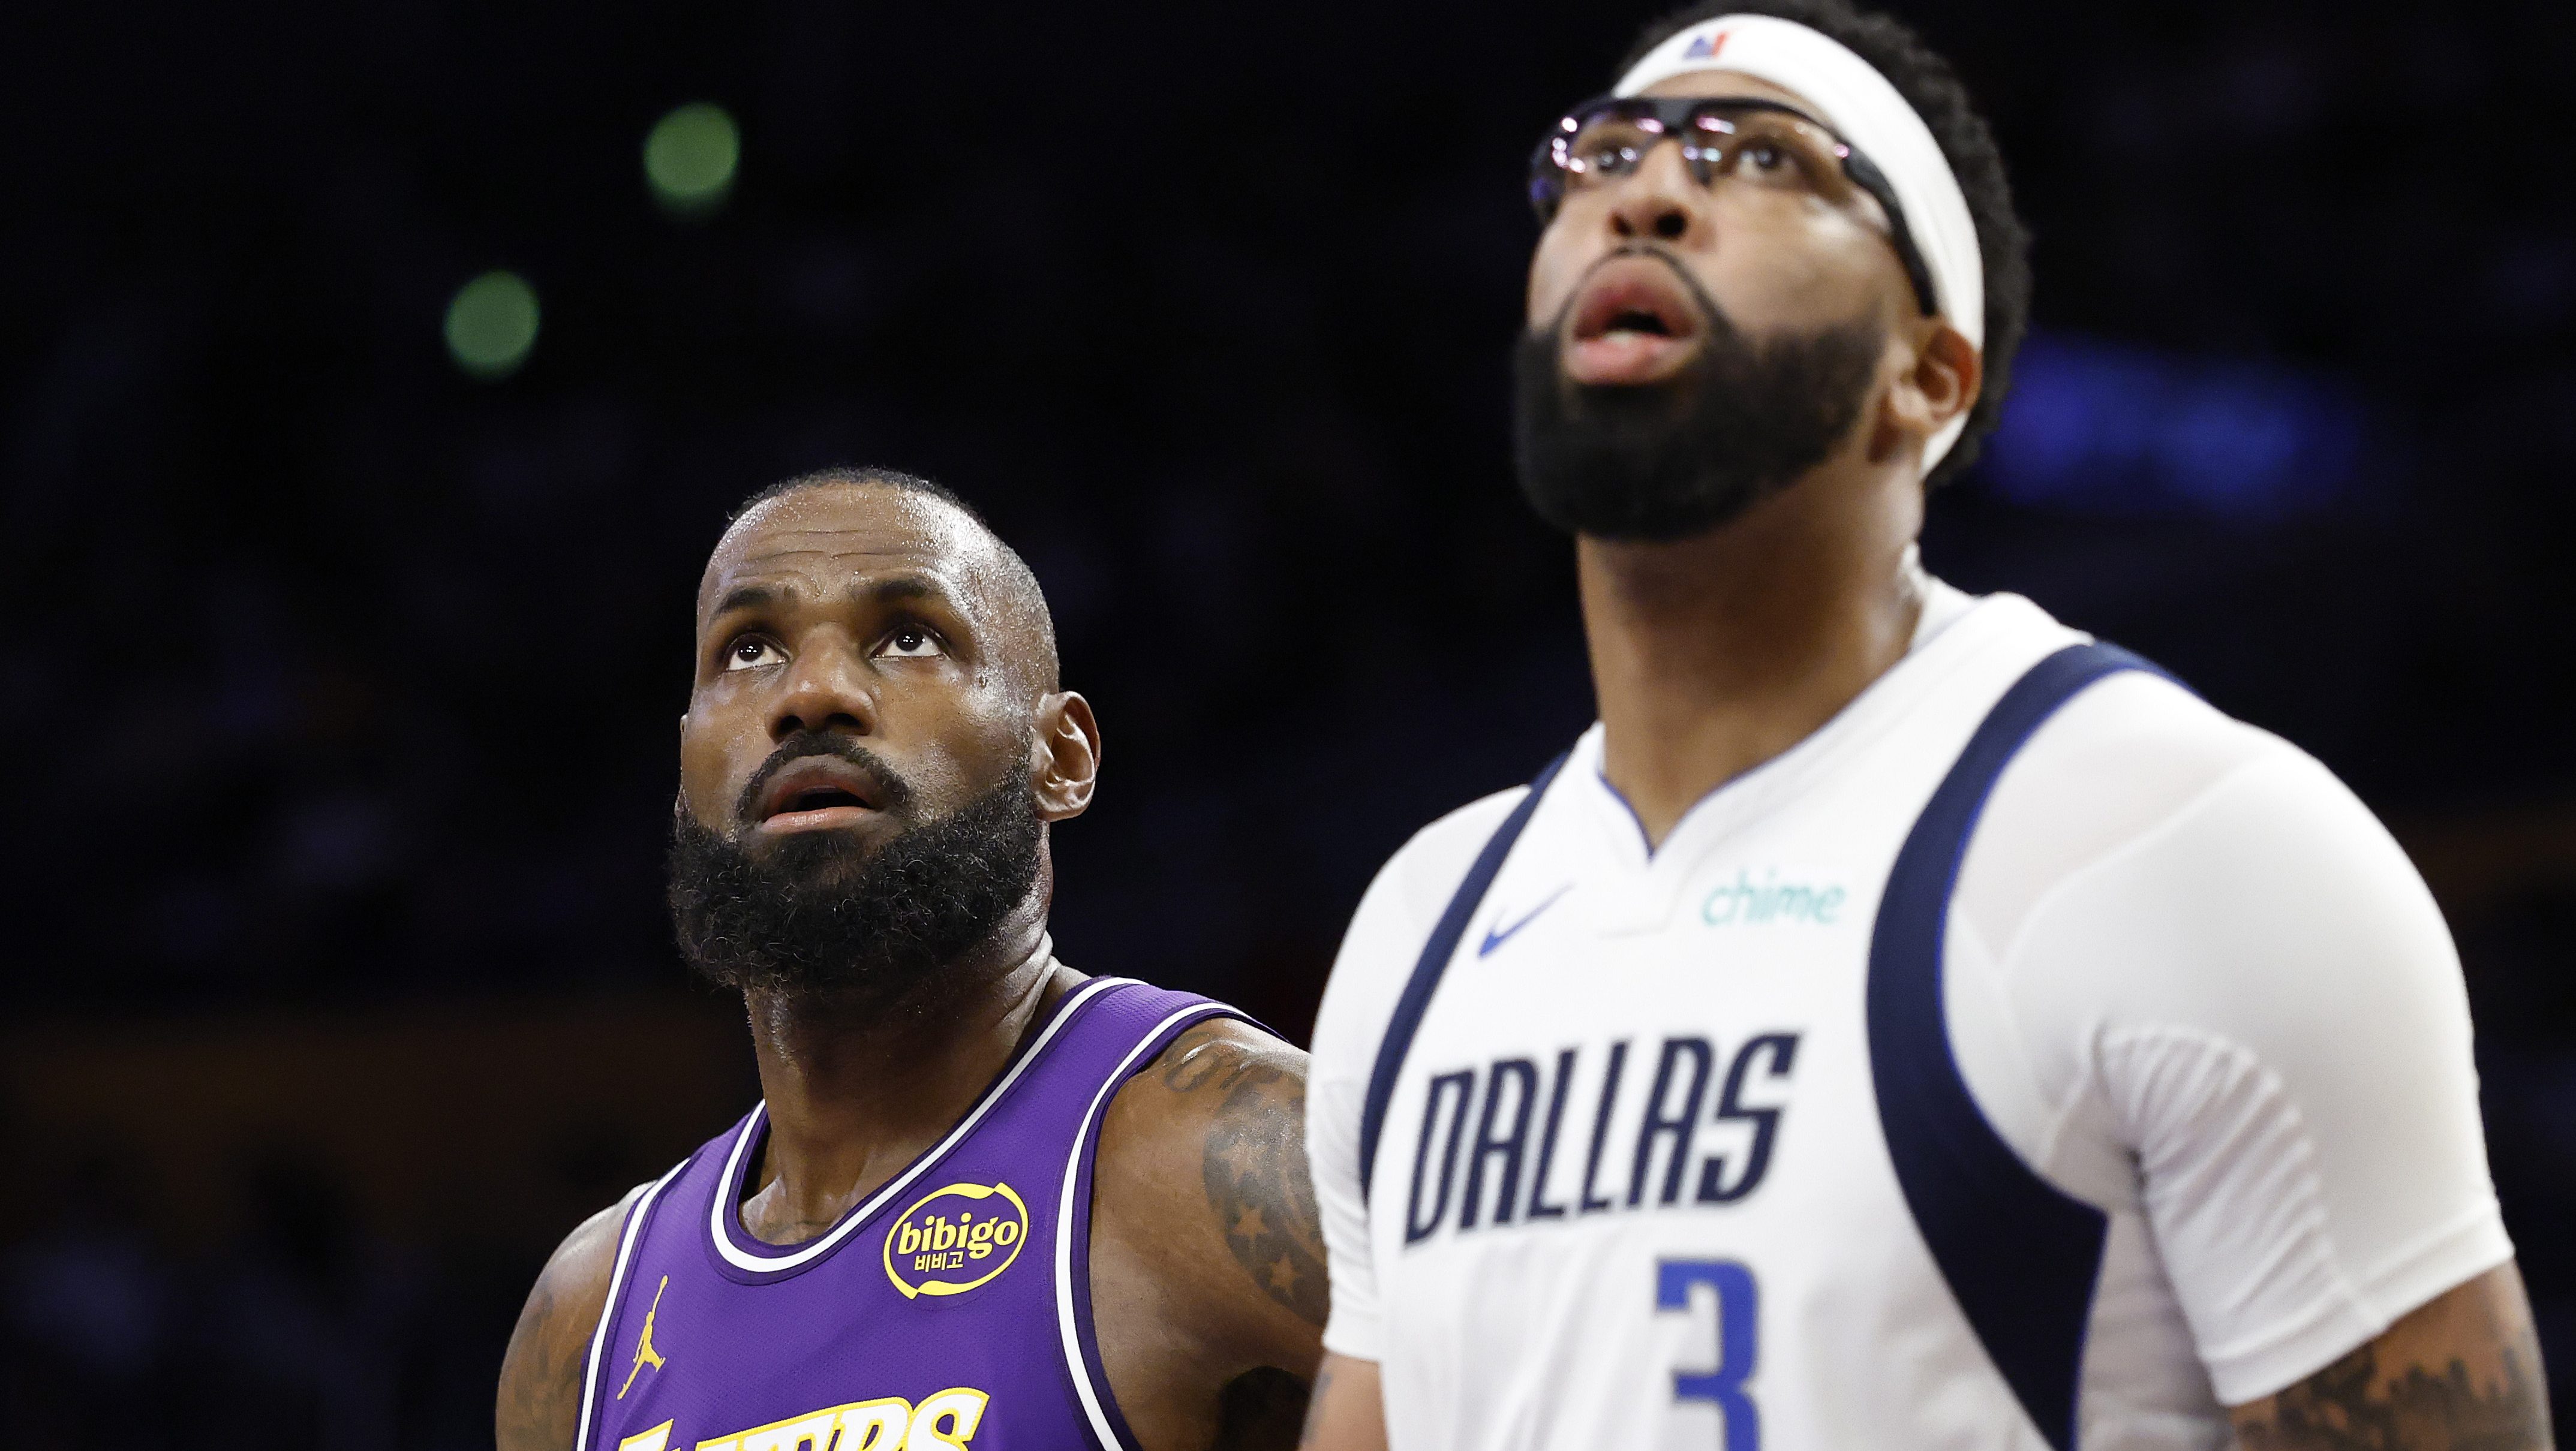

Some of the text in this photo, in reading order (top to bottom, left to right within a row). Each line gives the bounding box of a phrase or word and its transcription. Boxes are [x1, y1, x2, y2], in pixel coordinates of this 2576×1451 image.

[1702, 867, 1845, 925] chime
[1403, 1030, 1801, 1247] DALLAS
[898, 1212, 1019, 1259] bibigo
[914, 1251, 964, 1272] 비비고
[1654, 1257, 1760, 1451] 3
